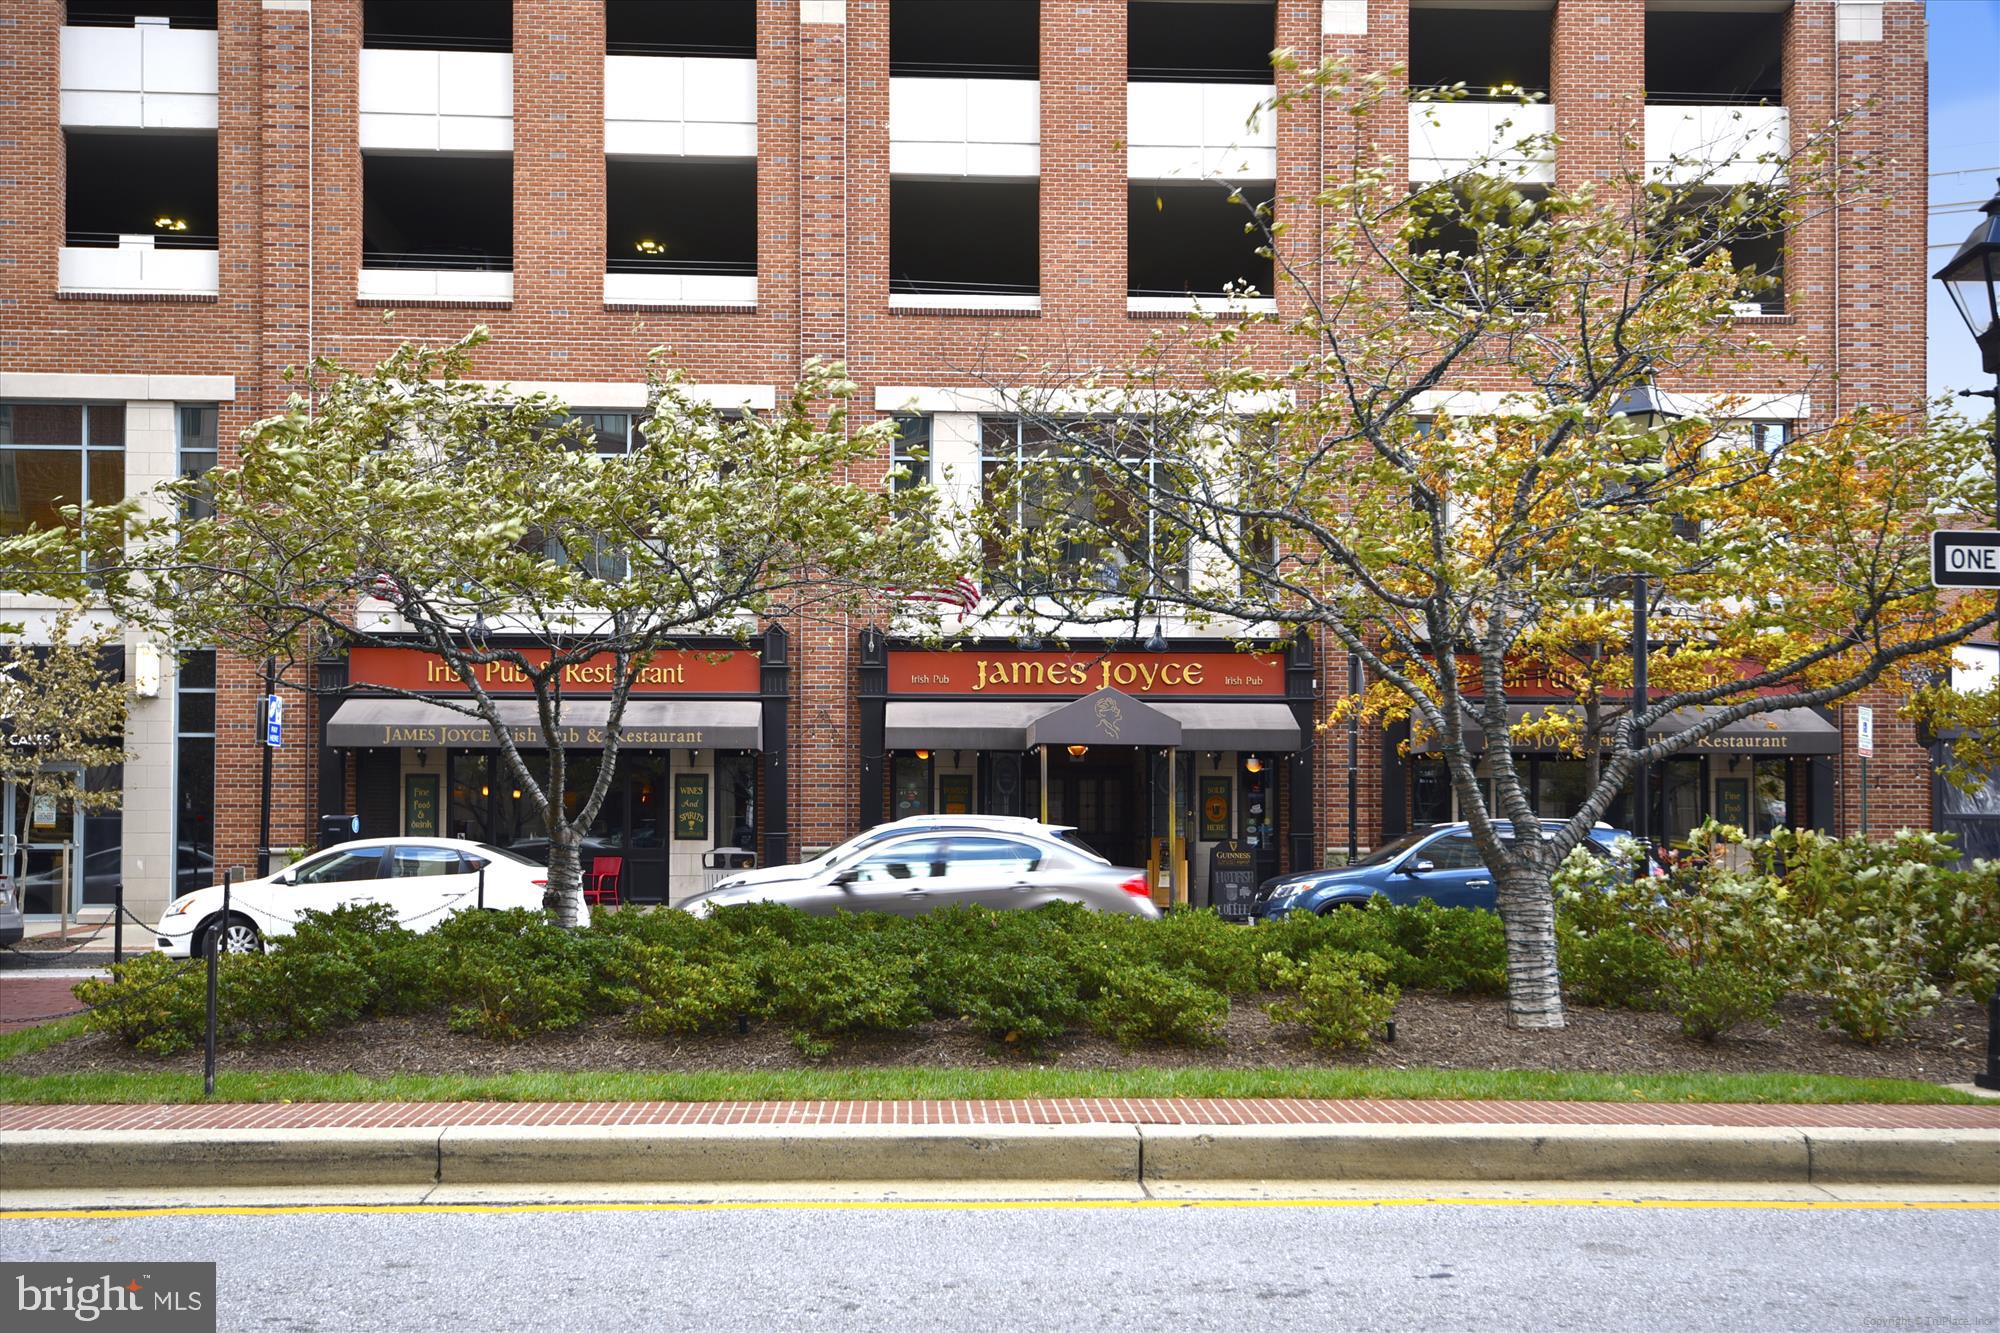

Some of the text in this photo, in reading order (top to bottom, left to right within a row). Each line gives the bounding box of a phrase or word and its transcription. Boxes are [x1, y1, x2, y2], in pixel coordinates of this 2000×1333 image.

[1951, 548, 1996, 570] ONE
[486, 660, 529, 683] Pub
[565, 662, 686, 683] Restrant
[911, 674, 950, 684] Irish Pub
[1225, 676, 1263, 685] Irish Pub
[383, 726, 436, 744] JAMES
[438, 726, 492, 745] JOYCE
[1216, 851, 1251, 859] GUINNESS
